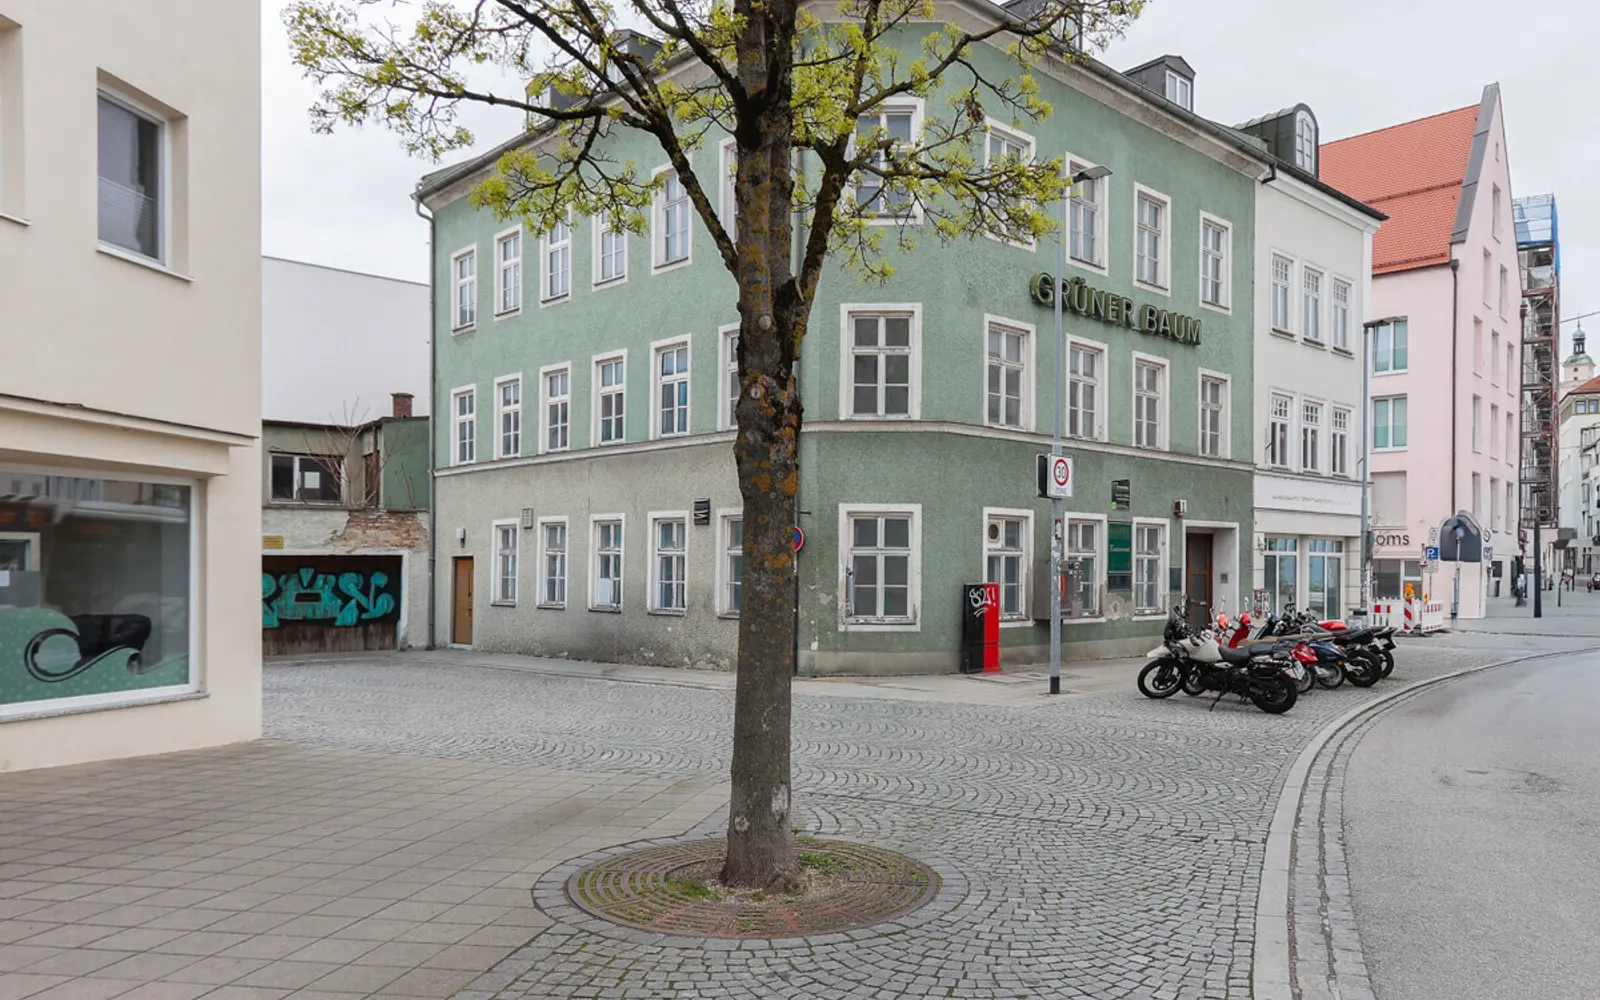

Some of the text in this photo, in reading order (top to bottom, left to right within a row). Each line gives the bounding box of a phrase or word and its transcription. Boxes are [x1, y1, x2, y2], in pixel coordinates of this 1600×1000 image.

[1030, 272, 1202, 346] GRÜNER BAUM
[1057, 464, 1066, 479] 30
